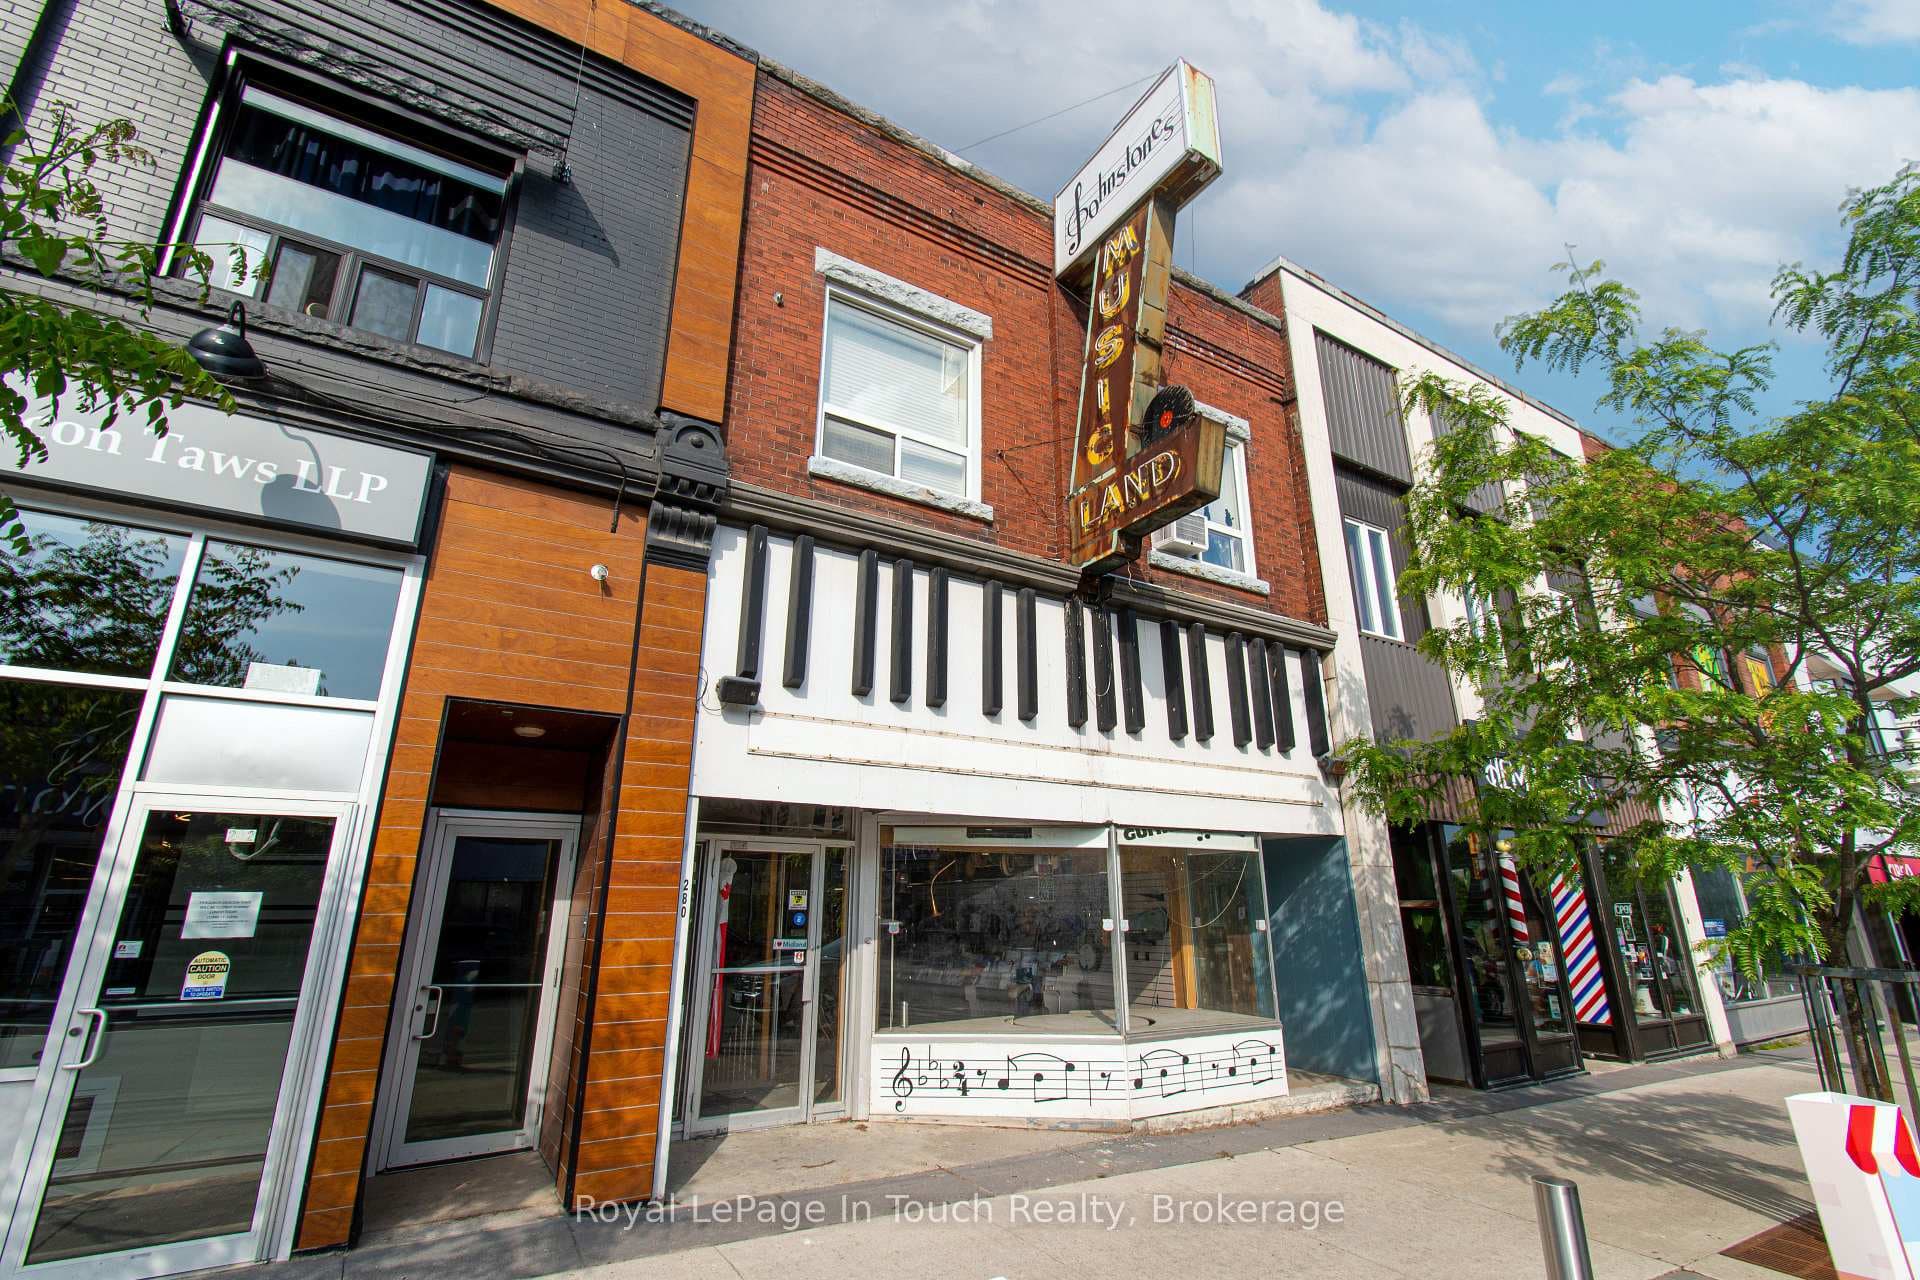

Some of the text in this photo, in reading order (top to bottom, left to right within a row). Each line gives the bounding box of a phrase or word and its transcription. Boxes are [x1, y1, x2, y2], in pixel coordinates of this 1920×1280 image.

[1086, 224, 1140, 466] MUSIC
[143, 426, 279, 485] Taws
[292, 459, 389, 504] LLP
[1080, 448, 1181, 533] LAND
[680, 879, 689, 918] 280
[190, 964, 228, 973] CAUTION
